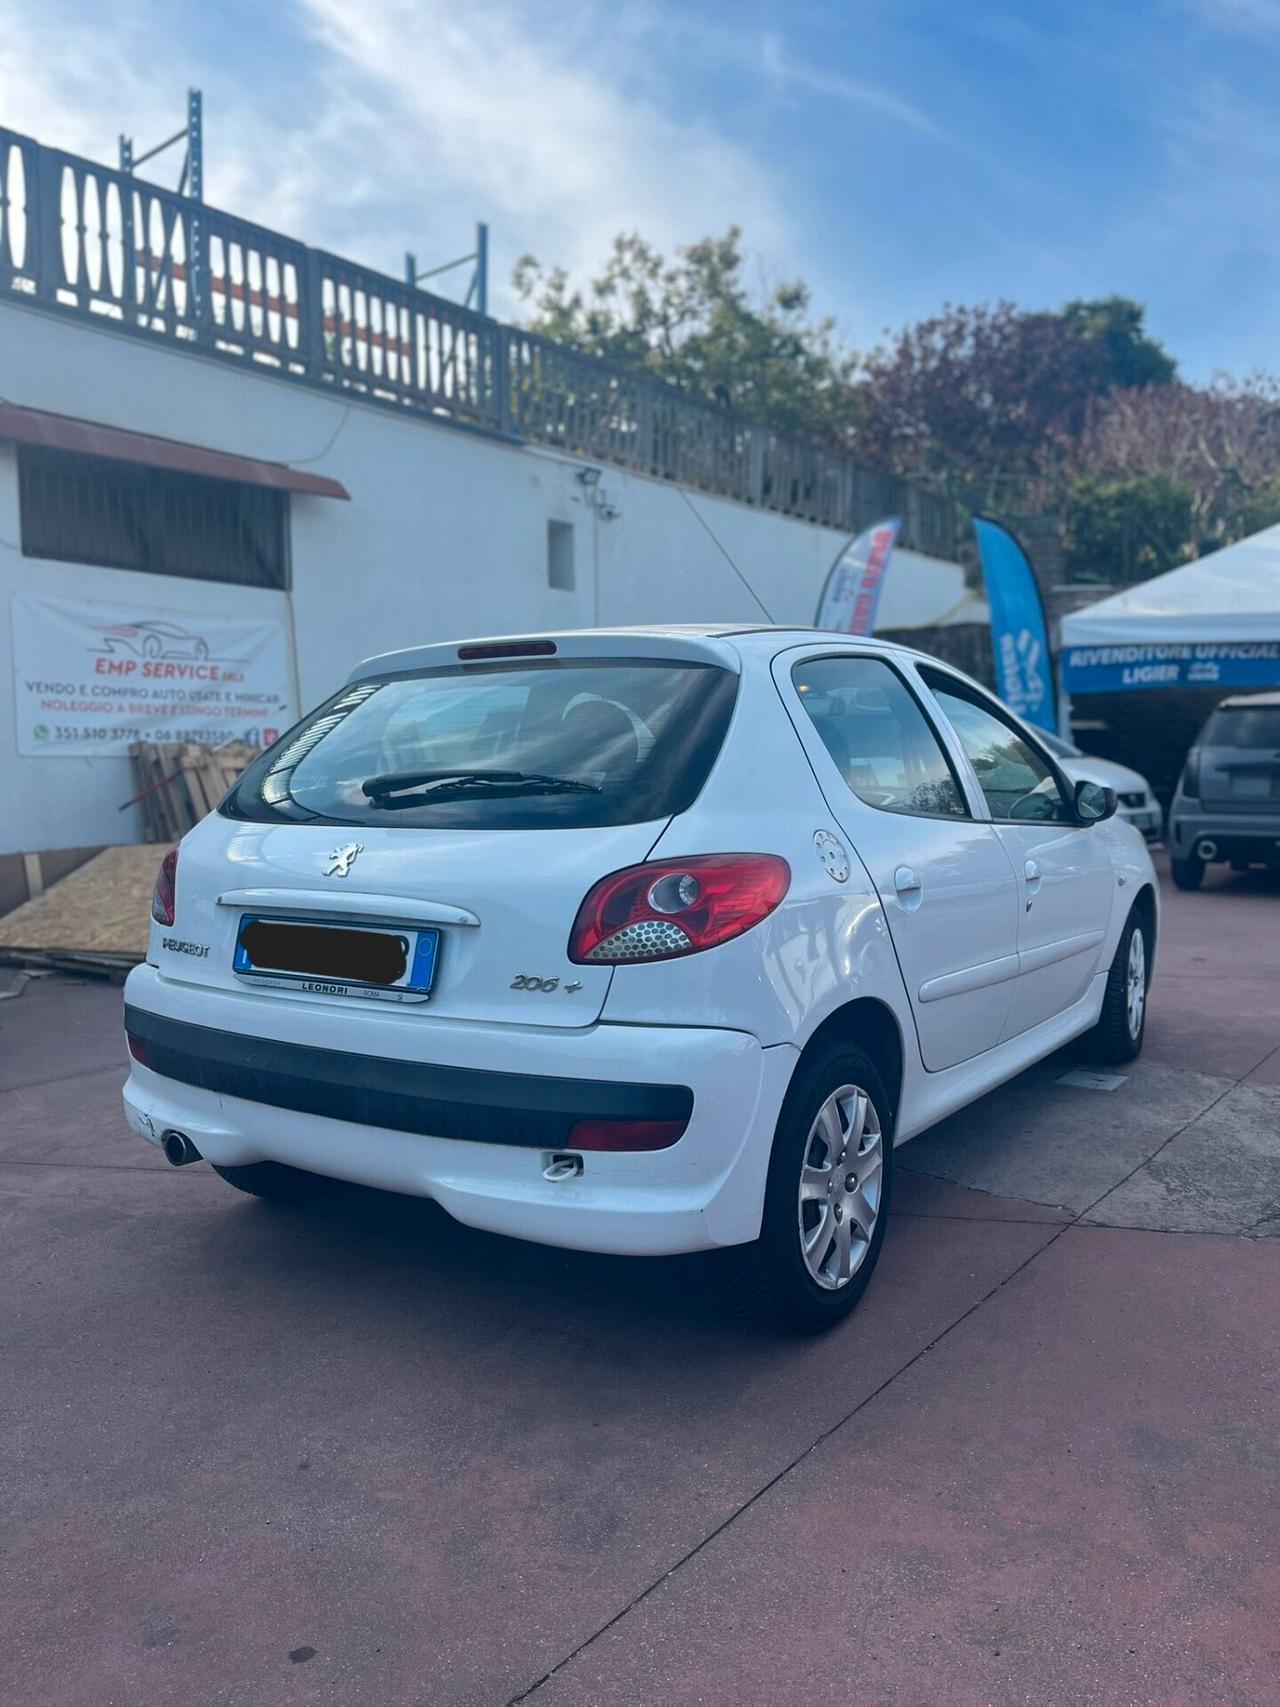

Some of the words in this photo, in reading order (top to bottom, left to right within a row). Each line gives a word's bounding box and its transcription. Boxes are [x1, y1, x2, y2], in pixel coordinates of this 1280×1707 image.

[1070, 645, 1192, 667] RIVENDITORE
[96, 657, 137, 676] EMP
[142, 661, 220, 681] SERVICE
[1122, 664, 1180, 684] LIGIER
[26, 681, 76, 695] VENDO
[80, 684, 87, 696] E
[91, 685, 149, 699] COMPRO
[152, 688, 186, 700] AUTO
[188, 690, 221, 702] USATE
[225, 691, 232, 703] E
[235, 692, 279, 704] MINICAR
[41, 699, 112, 713] NOLEGGIO
[116, 702, 125, 713] A
[128, 703, 166, 716] BREVE
[162, 937, 210, 959] PEUGEOT
[302, 982, 349, 995] LEONORI
[362, 989, 381, 998] ROMA
[510, 974, 560, 994] 206
